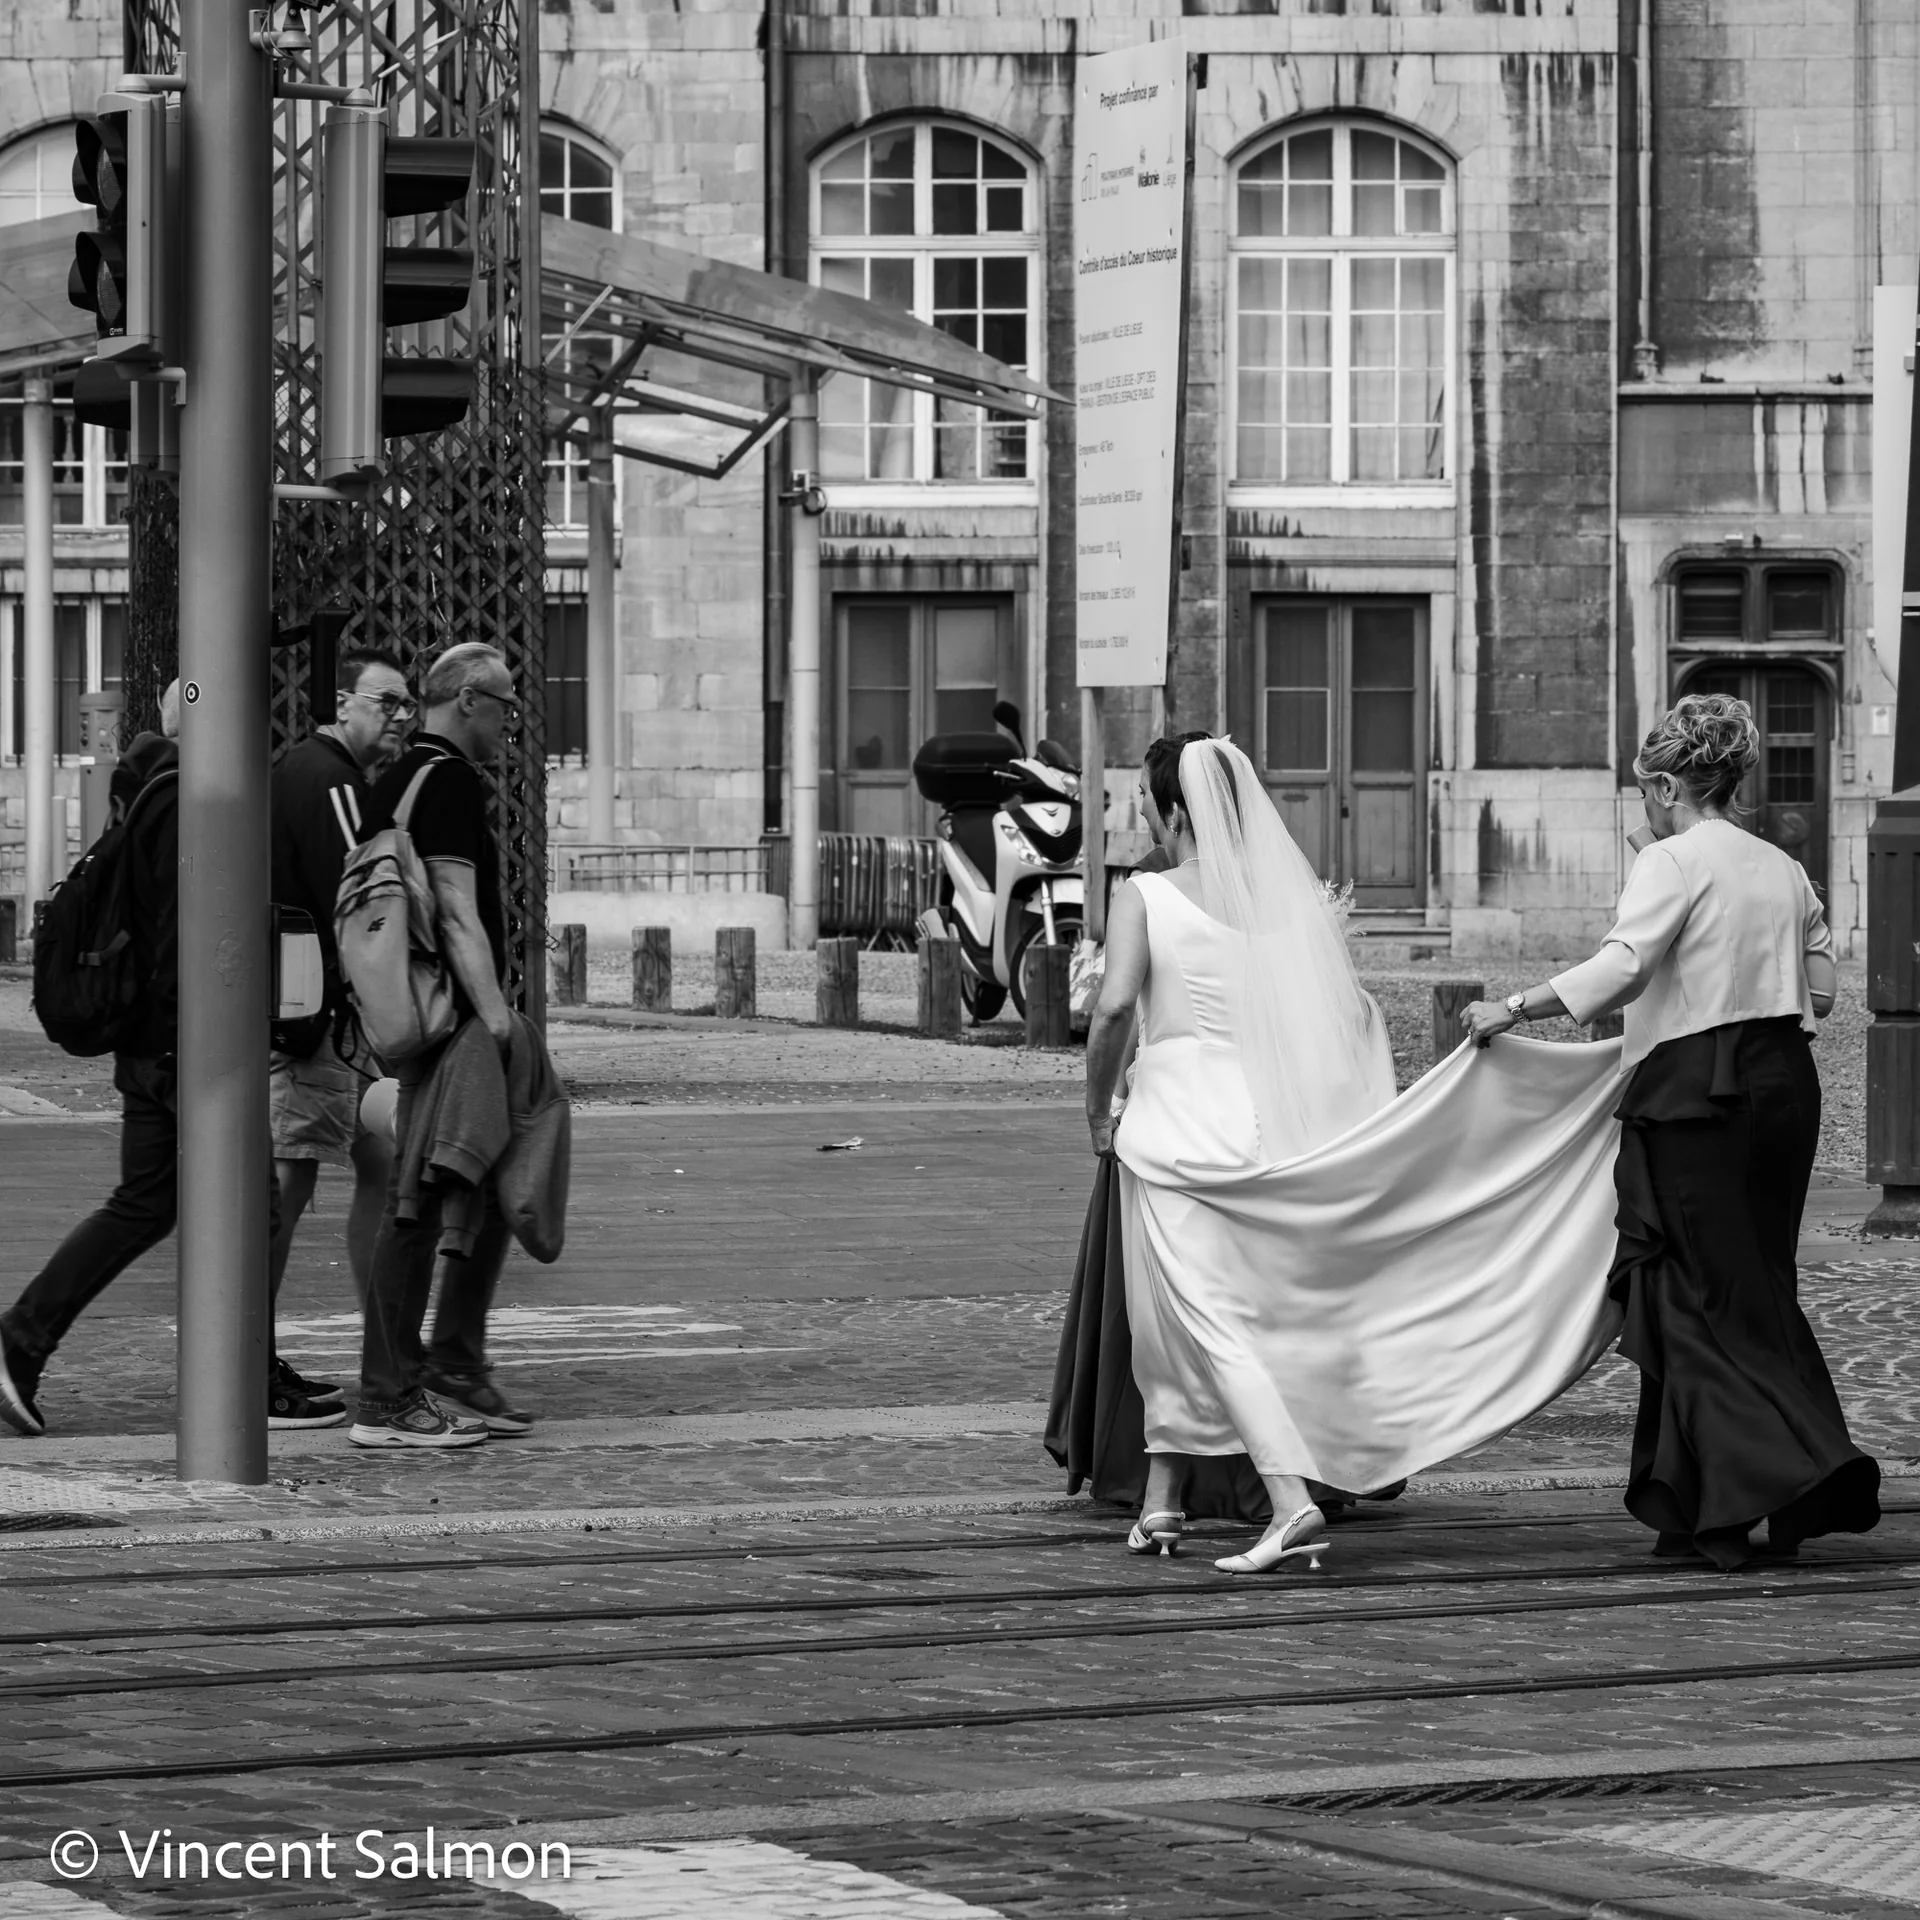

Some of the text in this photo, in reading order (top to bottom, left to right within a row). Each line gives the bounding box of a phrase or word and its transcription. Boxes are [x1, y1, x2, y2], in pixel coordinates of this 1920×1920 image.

[1100, 91, 1118, 111] Projet
[1148, 85, 1158, 103] par
[1138, 170, 1159, 188] Wallonie
[1128, 250, 1145, 266] Coeur
[1147, 245, 1177, 264] historique
